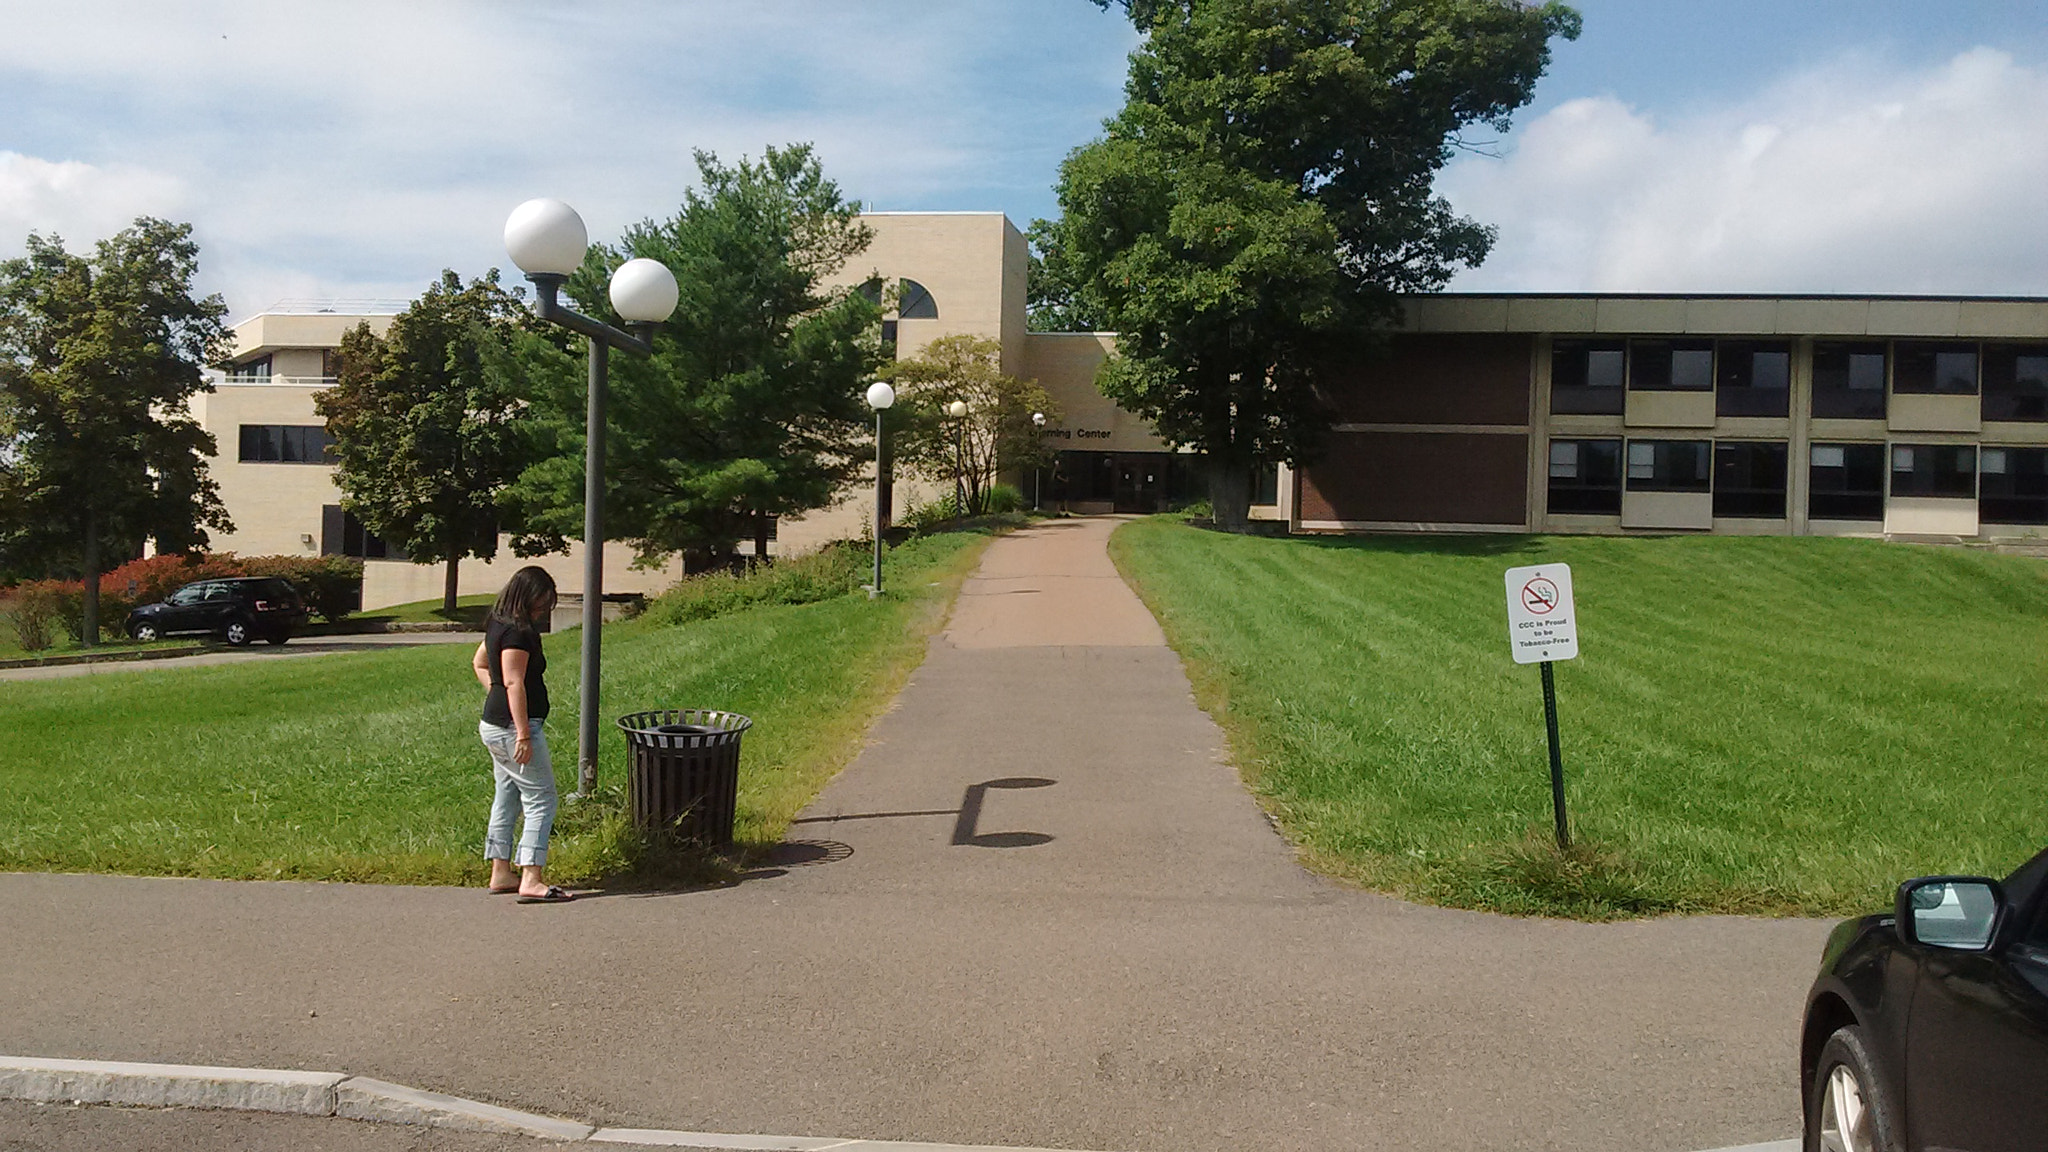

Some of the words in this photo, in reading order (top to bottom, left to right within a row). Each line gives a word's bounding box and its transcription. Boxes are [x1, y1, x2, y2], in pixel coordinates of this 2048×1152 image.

[1077, 428, 1111, 439] Center
[1518, 621, 1535, 629] CCC
[1545, 618, 1567, 626] Proud
[1519, 638, 1570, 647] Tobacco-Free
